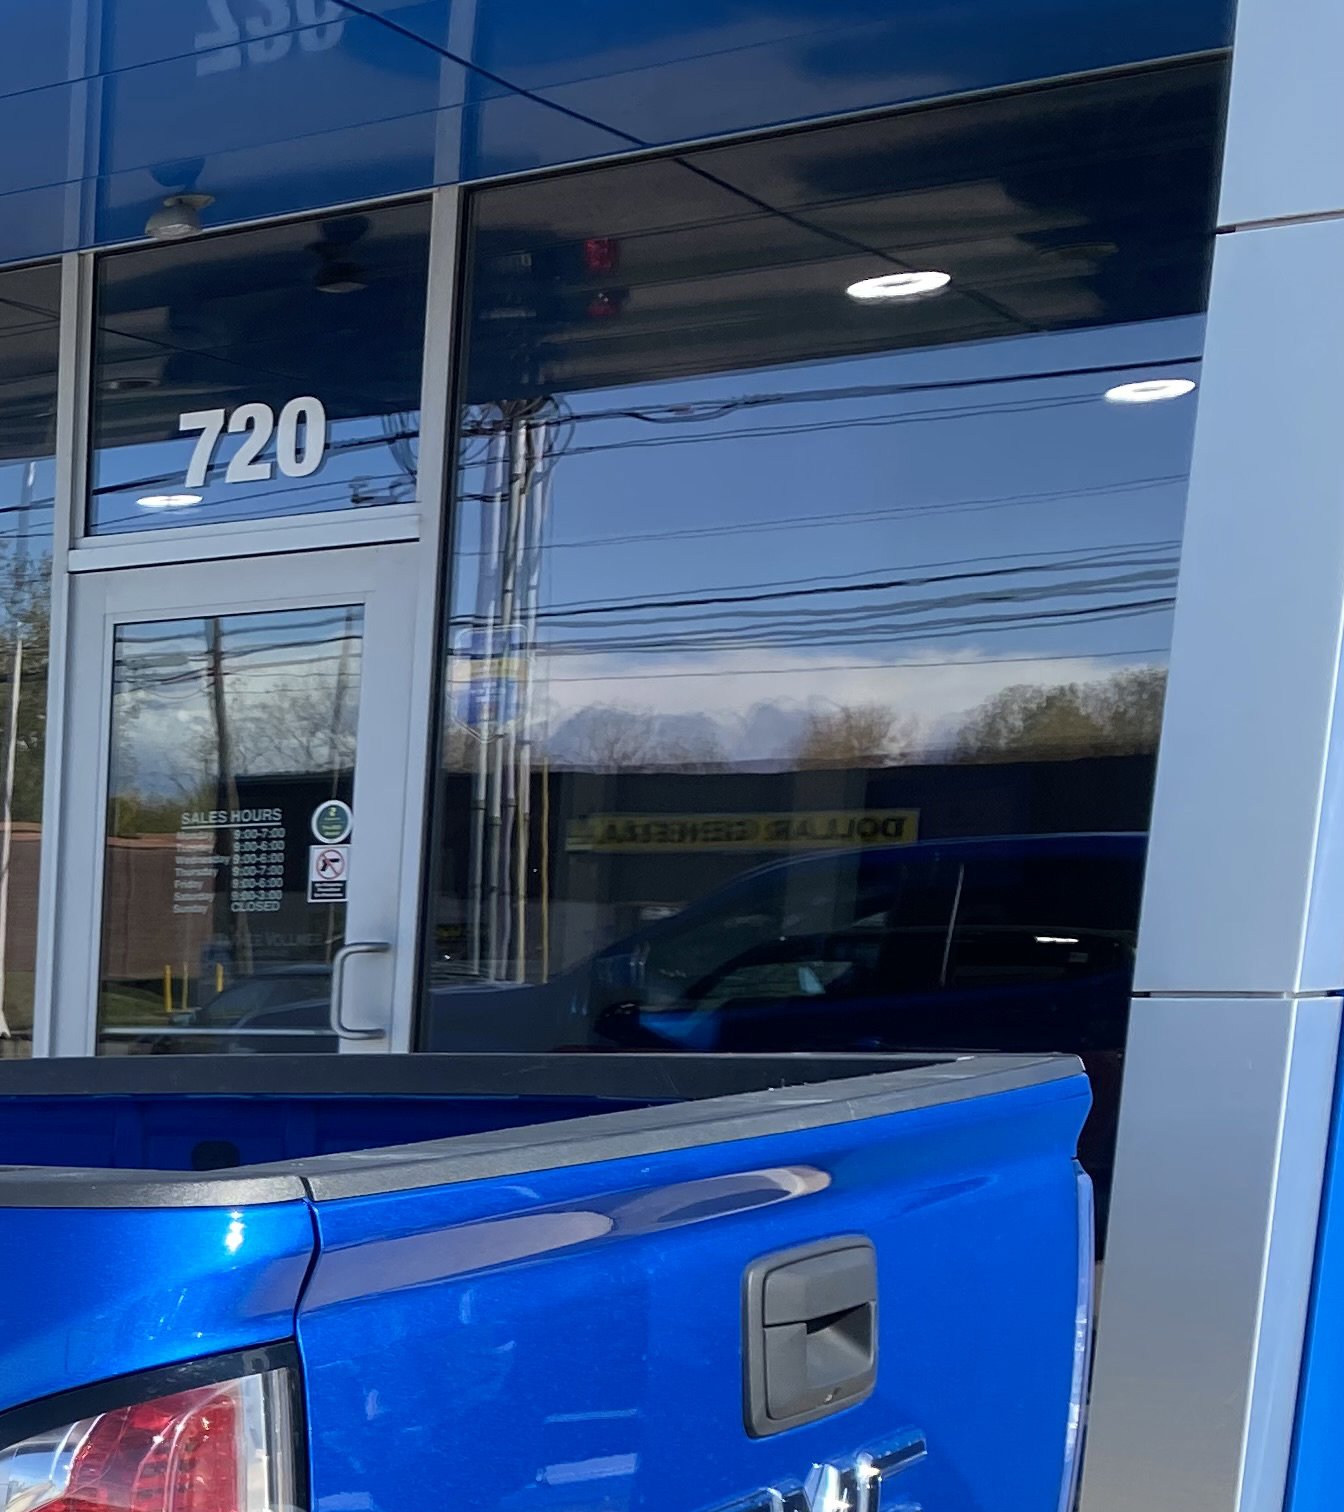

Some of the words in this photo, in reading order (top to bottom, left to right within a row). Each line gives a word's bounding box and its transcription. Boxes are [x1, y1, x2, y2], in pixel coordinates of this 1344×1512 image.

[177, 395, 328, 488] 720
[181, 810, 228, 825] SALES
[230, 807, 283, 823] HOURS
[231, 901, 280, 912] CLOSED
